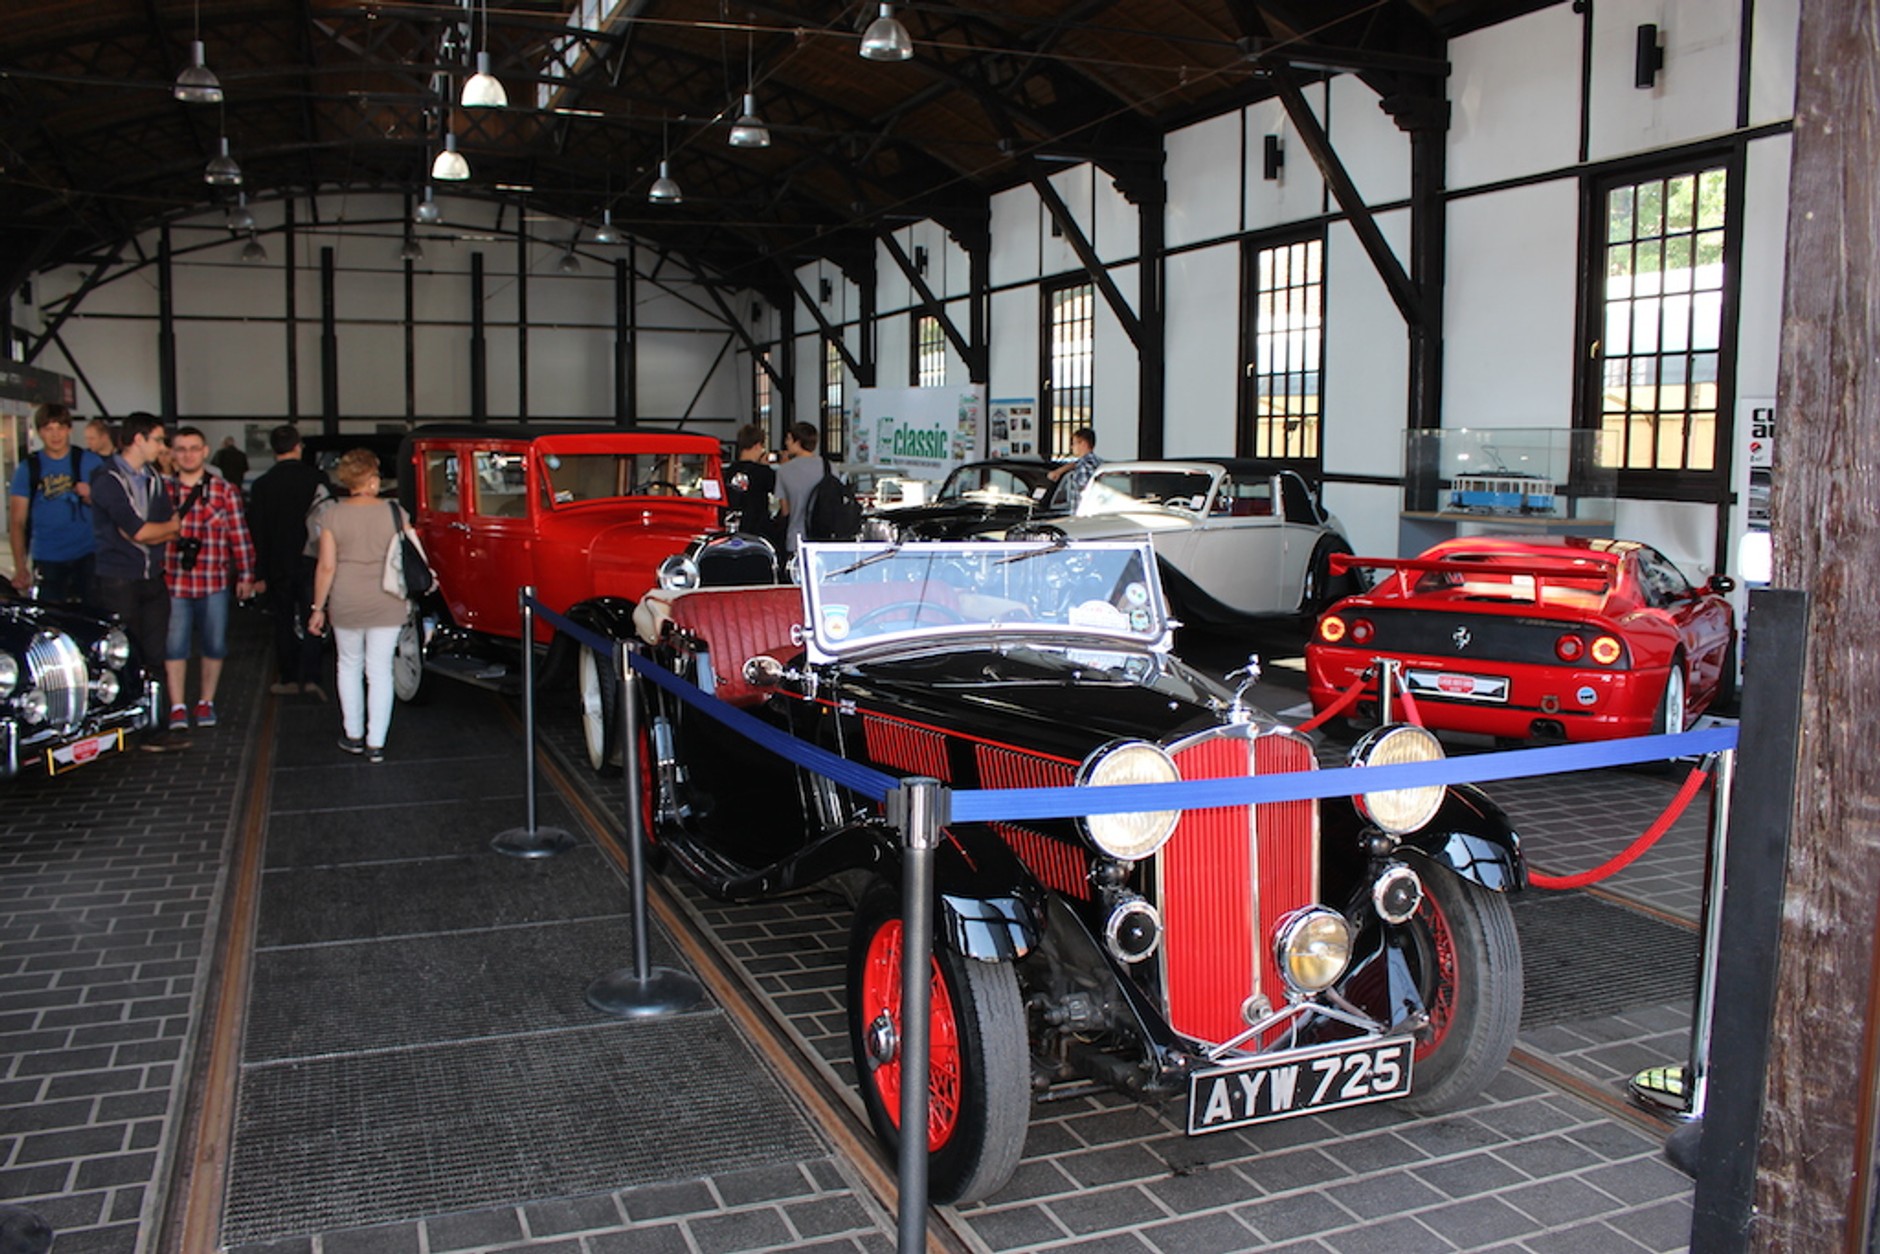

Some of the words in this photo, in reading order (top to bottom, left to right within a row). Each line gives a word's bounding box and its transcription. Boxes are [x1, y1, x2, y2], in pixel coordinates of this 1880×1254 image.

[894, 422, 947, 459] classic
[1203, 1065, 1298, 1125] AYW
[1310, 1047, 1401, 1106] 725
